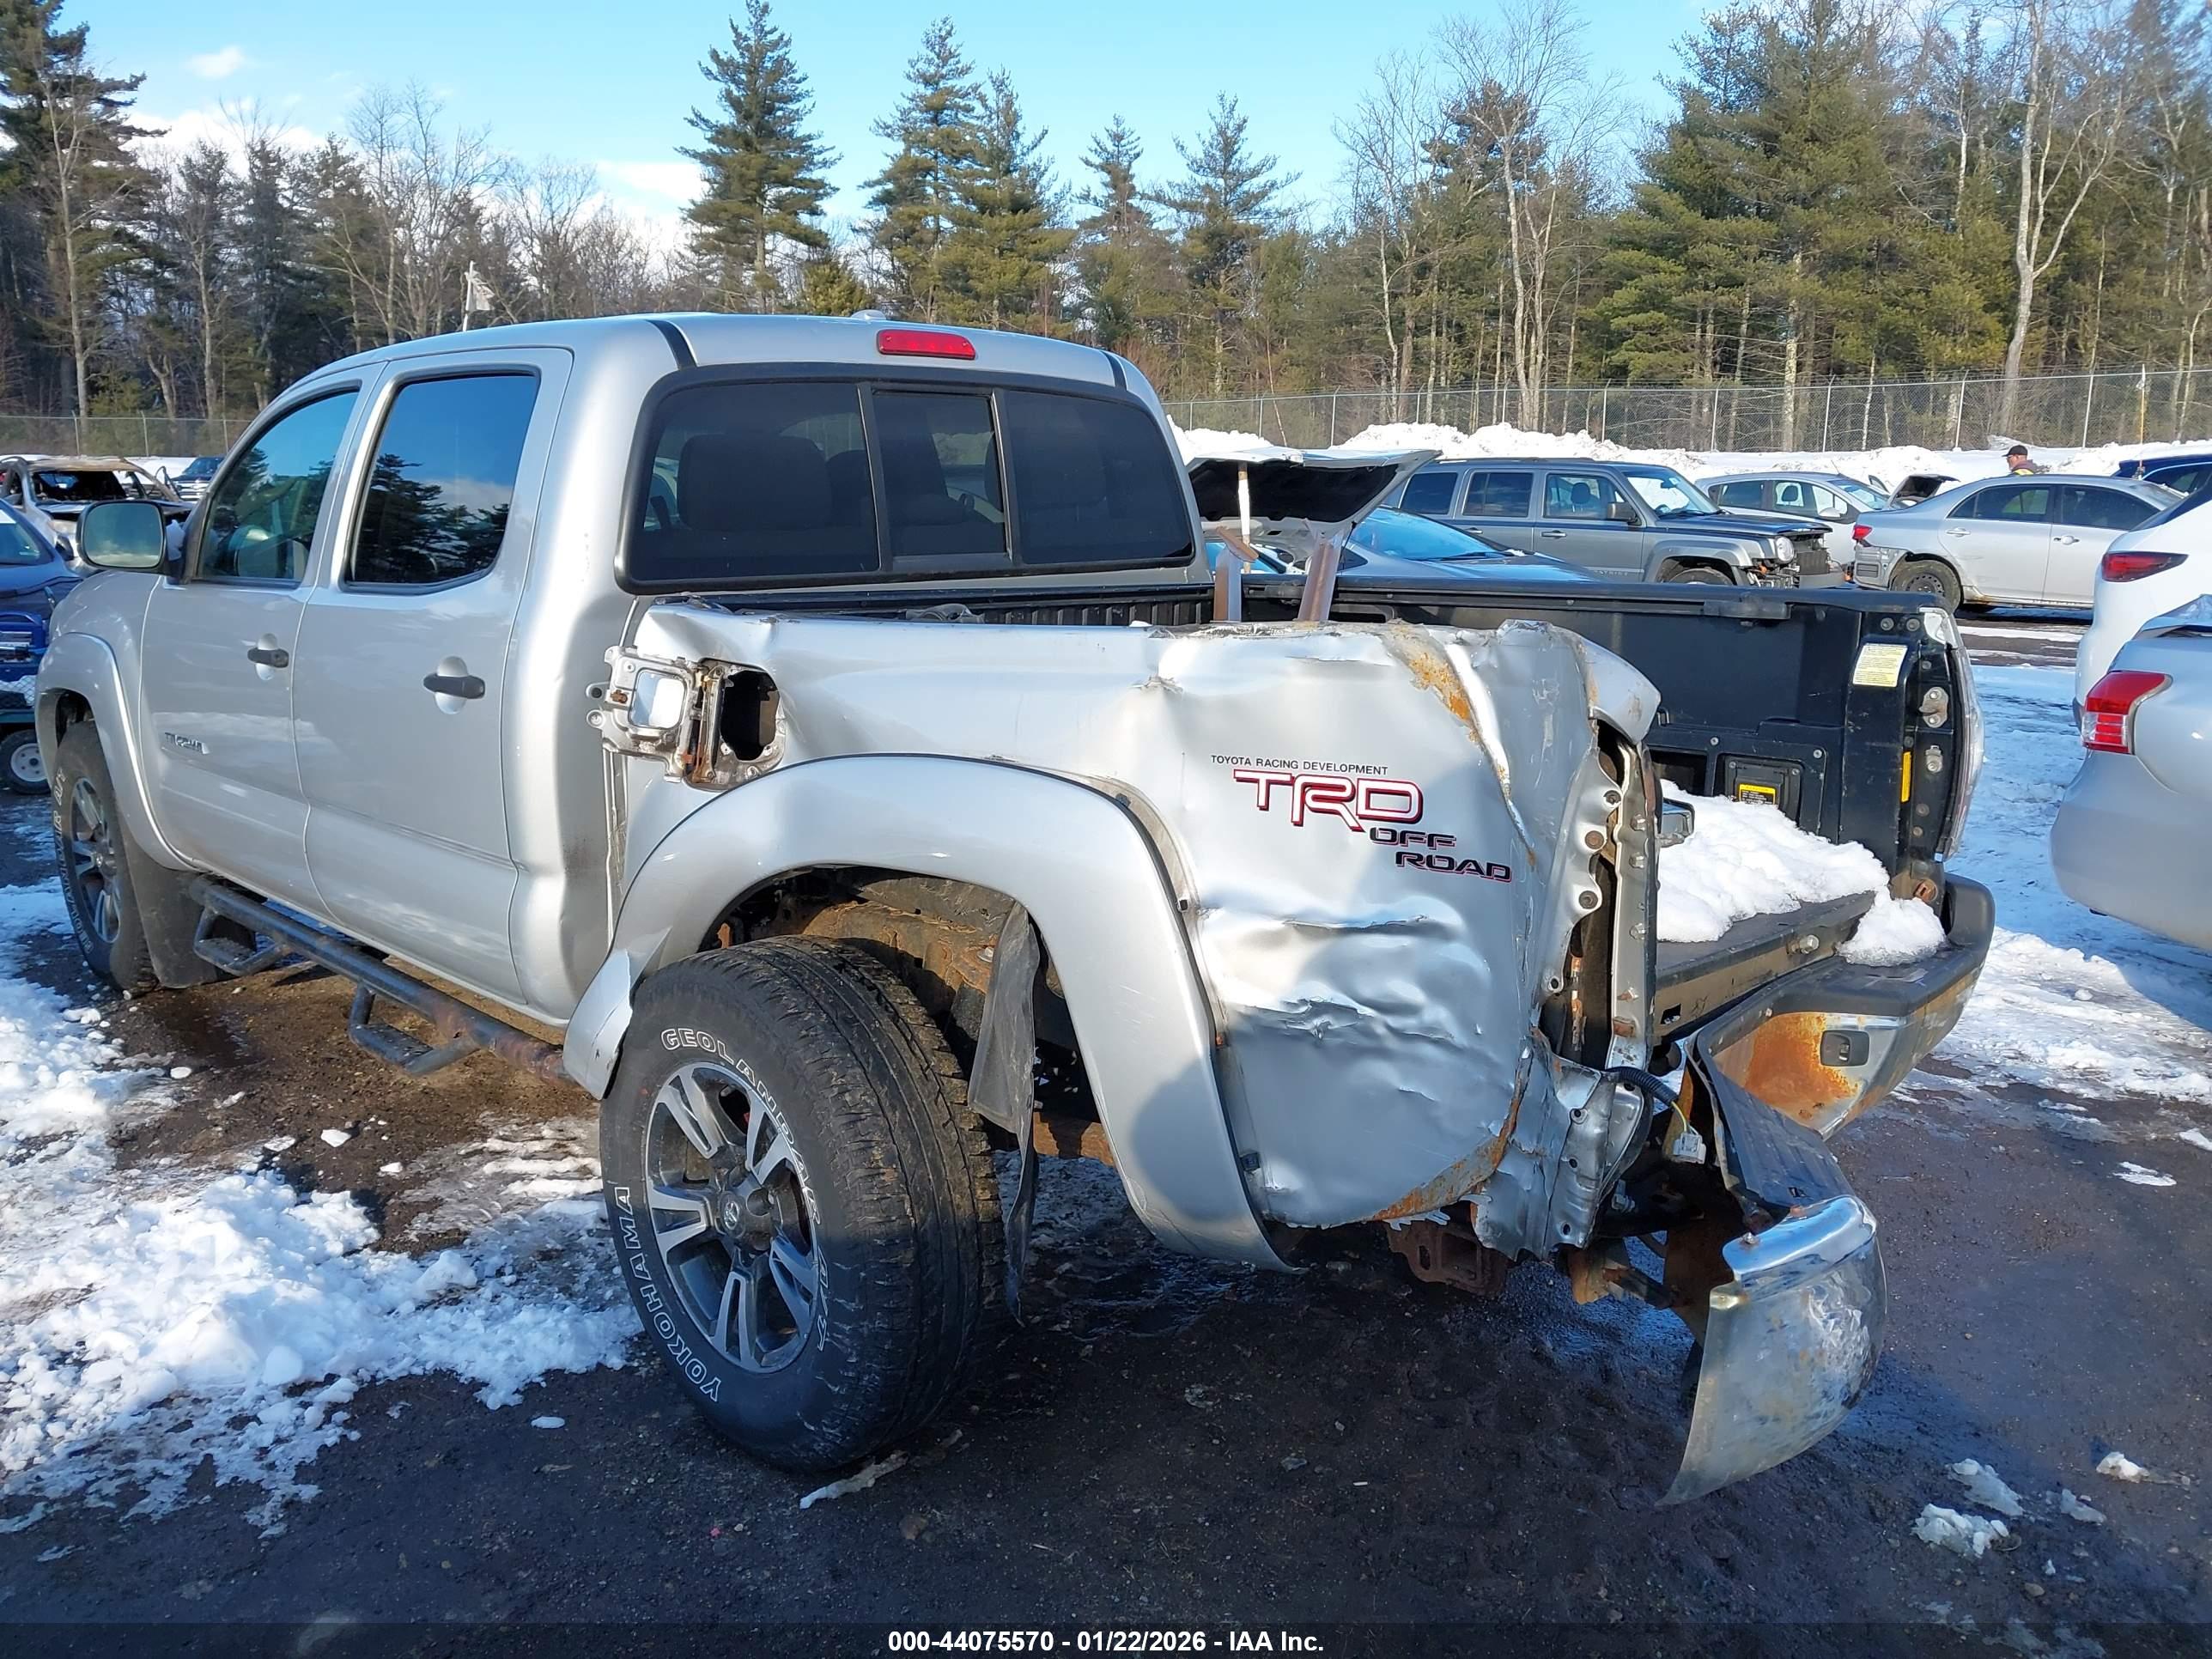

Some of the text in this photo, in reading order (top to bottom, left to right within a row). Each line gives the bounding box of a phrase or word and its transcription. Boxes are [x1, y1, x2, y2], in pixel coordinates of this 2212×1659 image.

[1211, 755, 1389, 775] TOYOTA RACING DEVELOPMENT
[1233, 769, 1424, 833] TRD
[1370, 827, 1457, 850] OFF
[1395, 851, 1512, 883] ROAD
[661, 1028, 820, 1224] GEOLANDAR
[614, 1187, 721, 1402] YOKOHAMA
